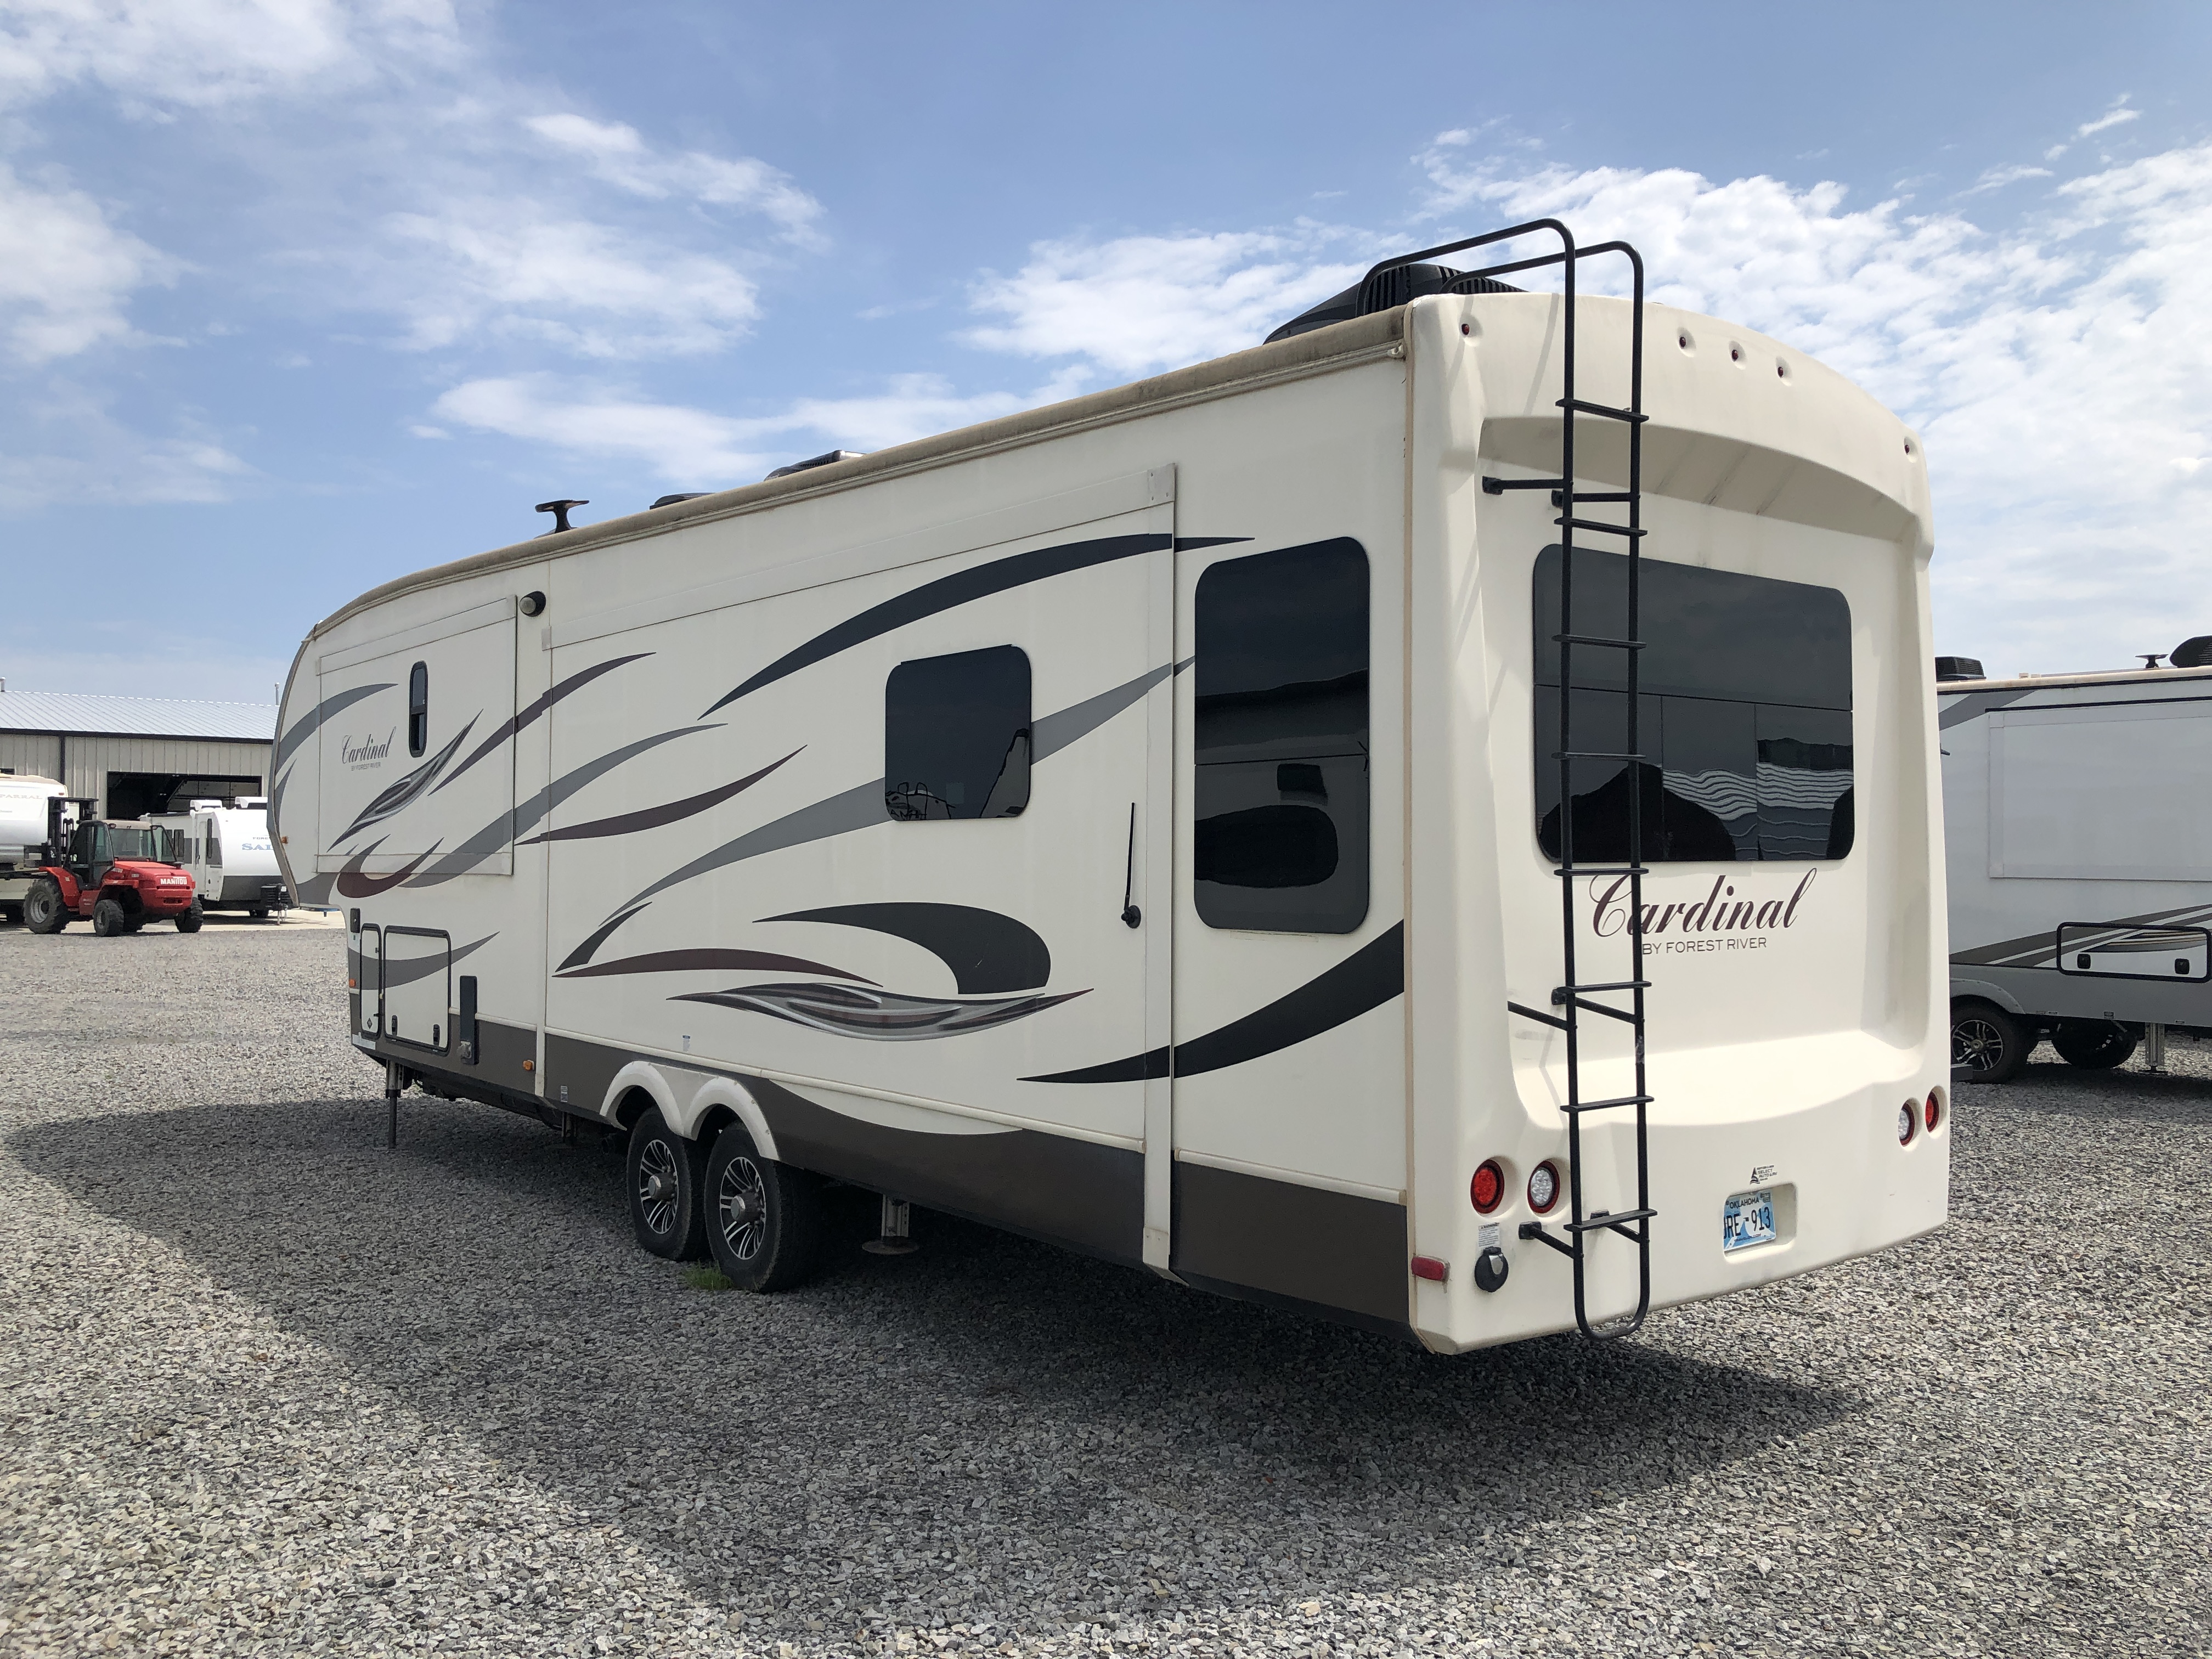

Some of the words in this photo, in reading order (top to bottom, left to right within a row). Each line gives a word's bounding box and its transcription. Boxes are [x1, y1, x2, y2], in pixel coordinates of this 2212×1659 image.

[342, 726, 396, 764] Cardinal
[160, 877, 187, 885] MANITOU
[1589, 867, 1818, 937] Cardinal
[1642, 943, 1662, 955] BY
[1666, 939, 1723, 954] FOREST
[1726, 937, 1767, 950] RIVER
[1730, 1197, 1759, 1209] OKLAHOMA
